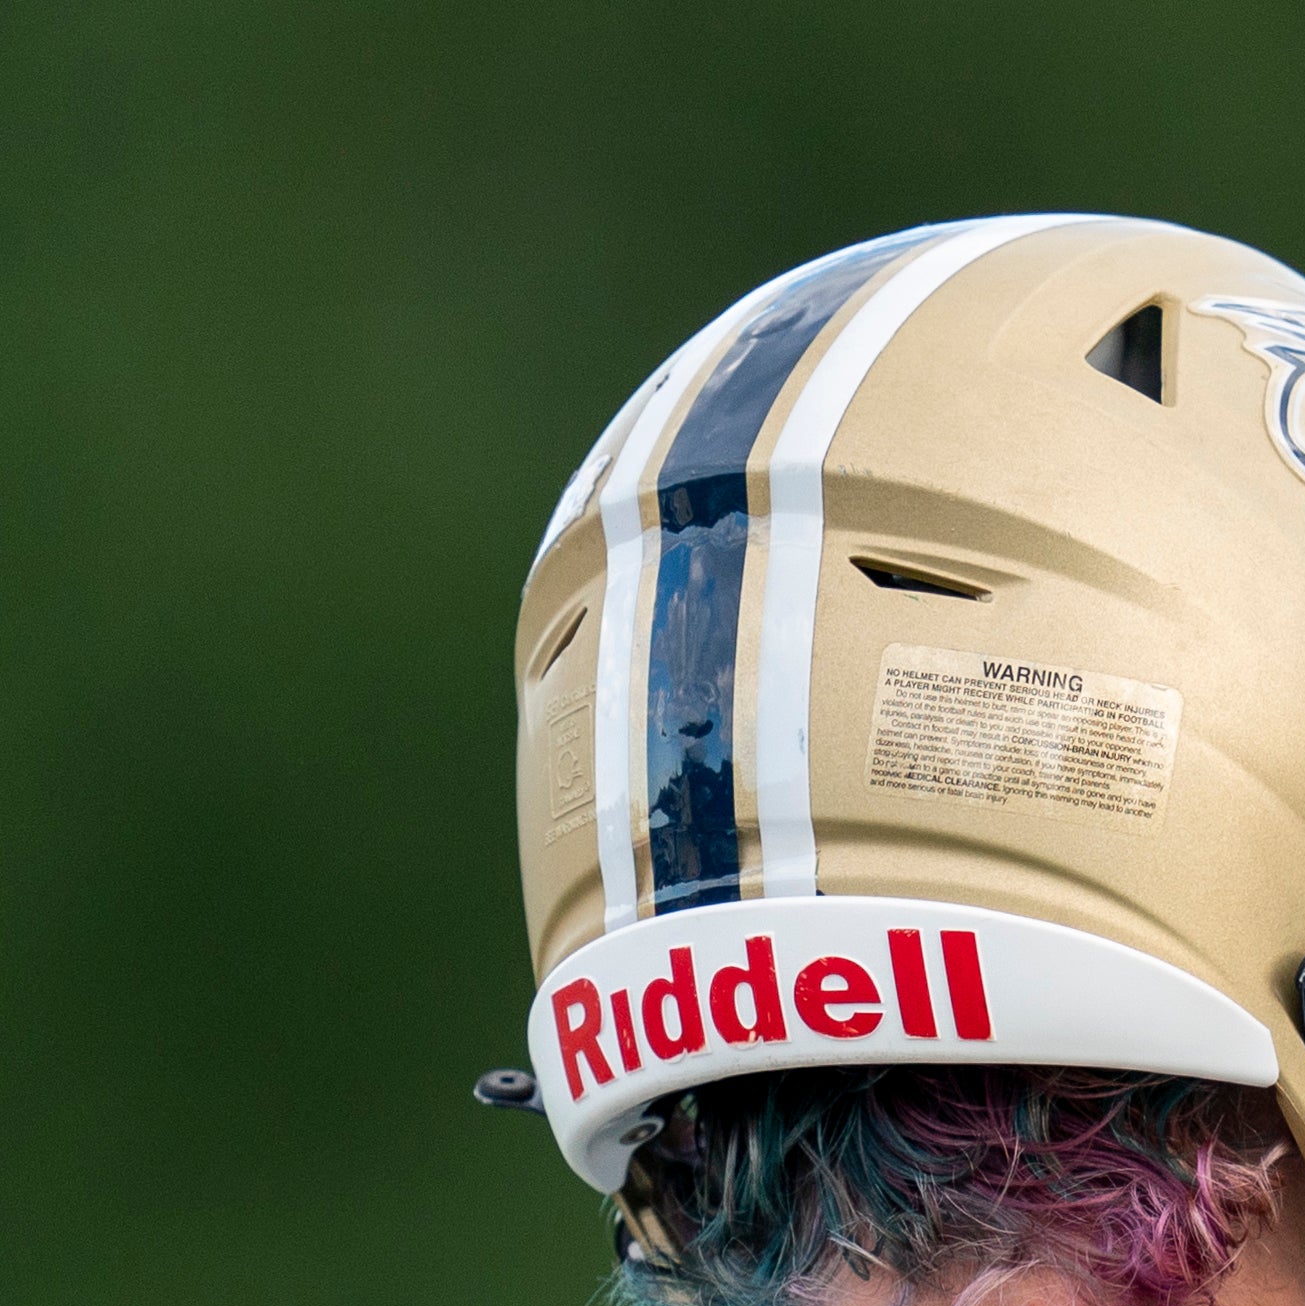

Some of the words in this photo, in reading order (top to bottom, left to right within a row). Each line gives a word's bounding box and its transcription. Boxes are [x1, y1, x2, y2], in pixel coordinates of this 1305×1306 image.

[983, 661, 1083, 692] WARNING
[885, 677, 892, 686] A
[894, 678, 930, 690] PLAYER
[932, 683, 961, 695] MIGHT
[963, 687, 1004, 701] RECEIVE
[1005, 694, 1035, 705] WHILE
[1037, 699, 1105, 717] PARTICIPATING
[1107, 711, 1116, 719] IN
[1118, 713, 1165, 729] FOOTBALL
[886, 667, 901, 677] NO
[902, 669, 939, 682] HELMET
[941, 674, 962, 685] CAN
[964, 677, 1007, 691] PREVENT
[1009, 684, 1050, 698] SERIOUS
[1053, 691, 1079, 702] HEAD
[1081, 696, 1095, 705] OR
[1096, 699, 1122, 711] NECK
[1124, 704, 1166, 719] INJURIES
[896, 689, 908, 698] Do
[909, 691, 922, 699] not
[983, 701, 990, 709] to
[924, 703, 937, 711] the
[938, 704, 966, 715] football
[988, 712, 1003, 720] and
[989, 723, 1004, 732] you
[891, 718, 922, 730] Contact
[1100, 750, 1132, 762] INJURY
[873, 757, 884, 766] Do
[993, 764, 1010, 774] your
[1041, 762, 1055, 770] you
[550, 928, 995, 1101] Riddell
